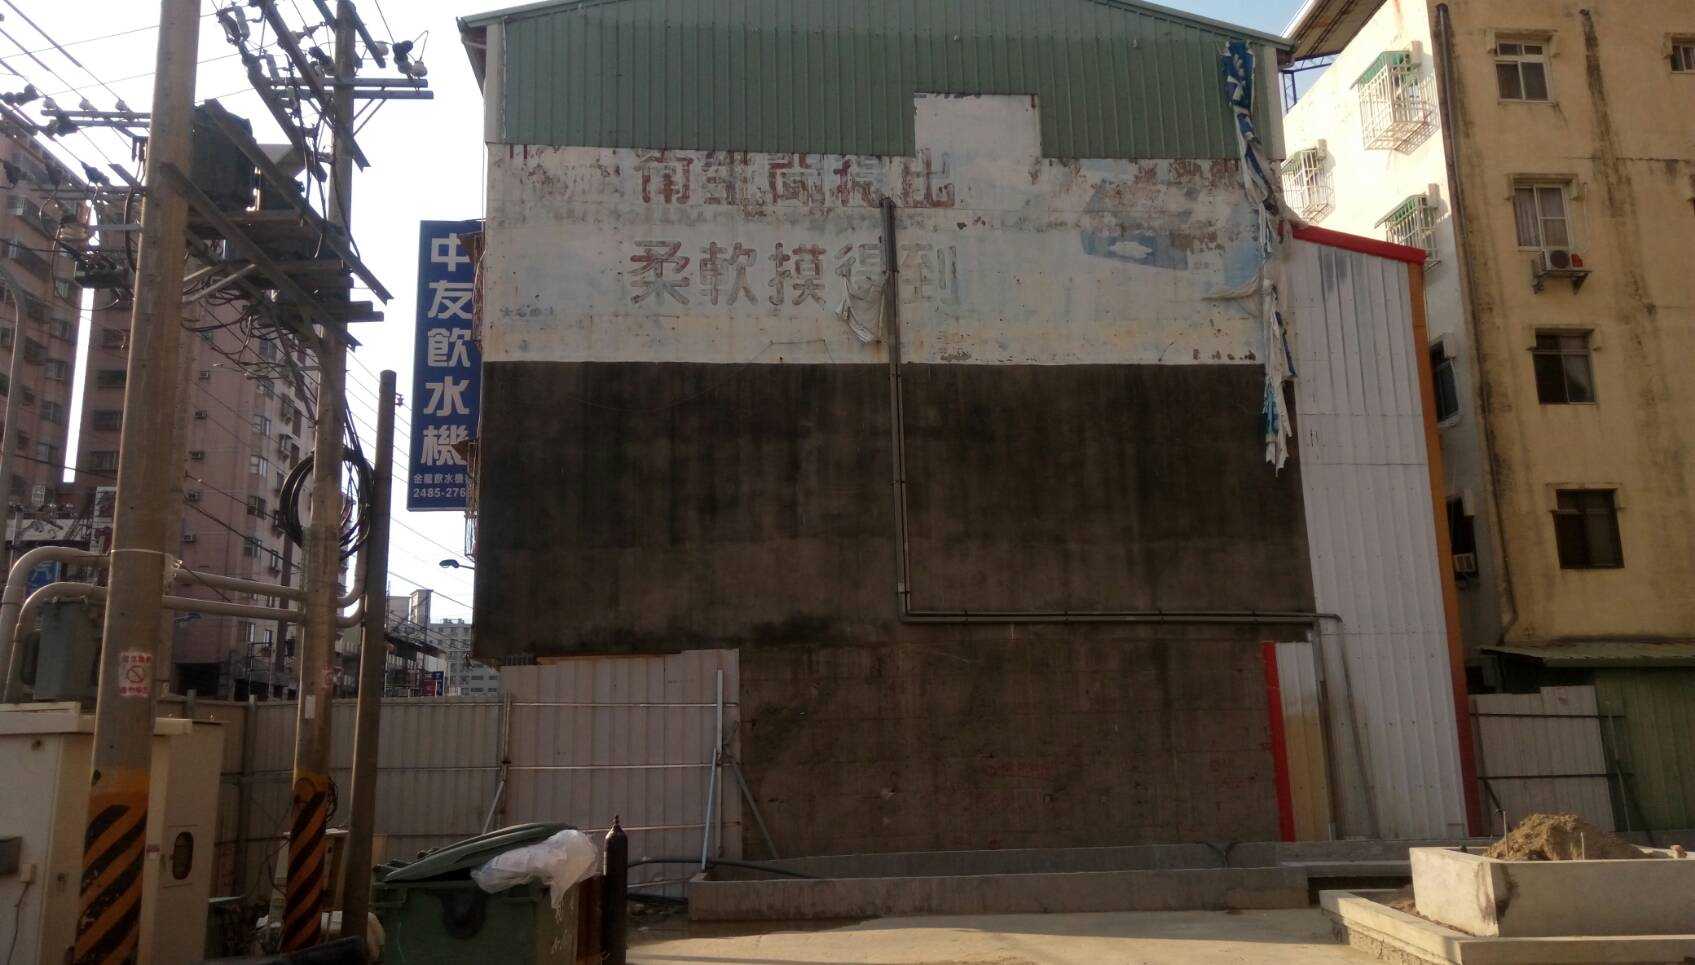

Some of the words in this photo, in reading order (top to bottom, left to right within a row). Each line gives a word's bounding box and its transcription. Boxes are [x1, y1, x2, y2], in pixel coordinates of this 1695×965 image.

[630, 240, 957, 306] 柔軟摸得到
[421, 232, 473, 466] 中友飲水機
